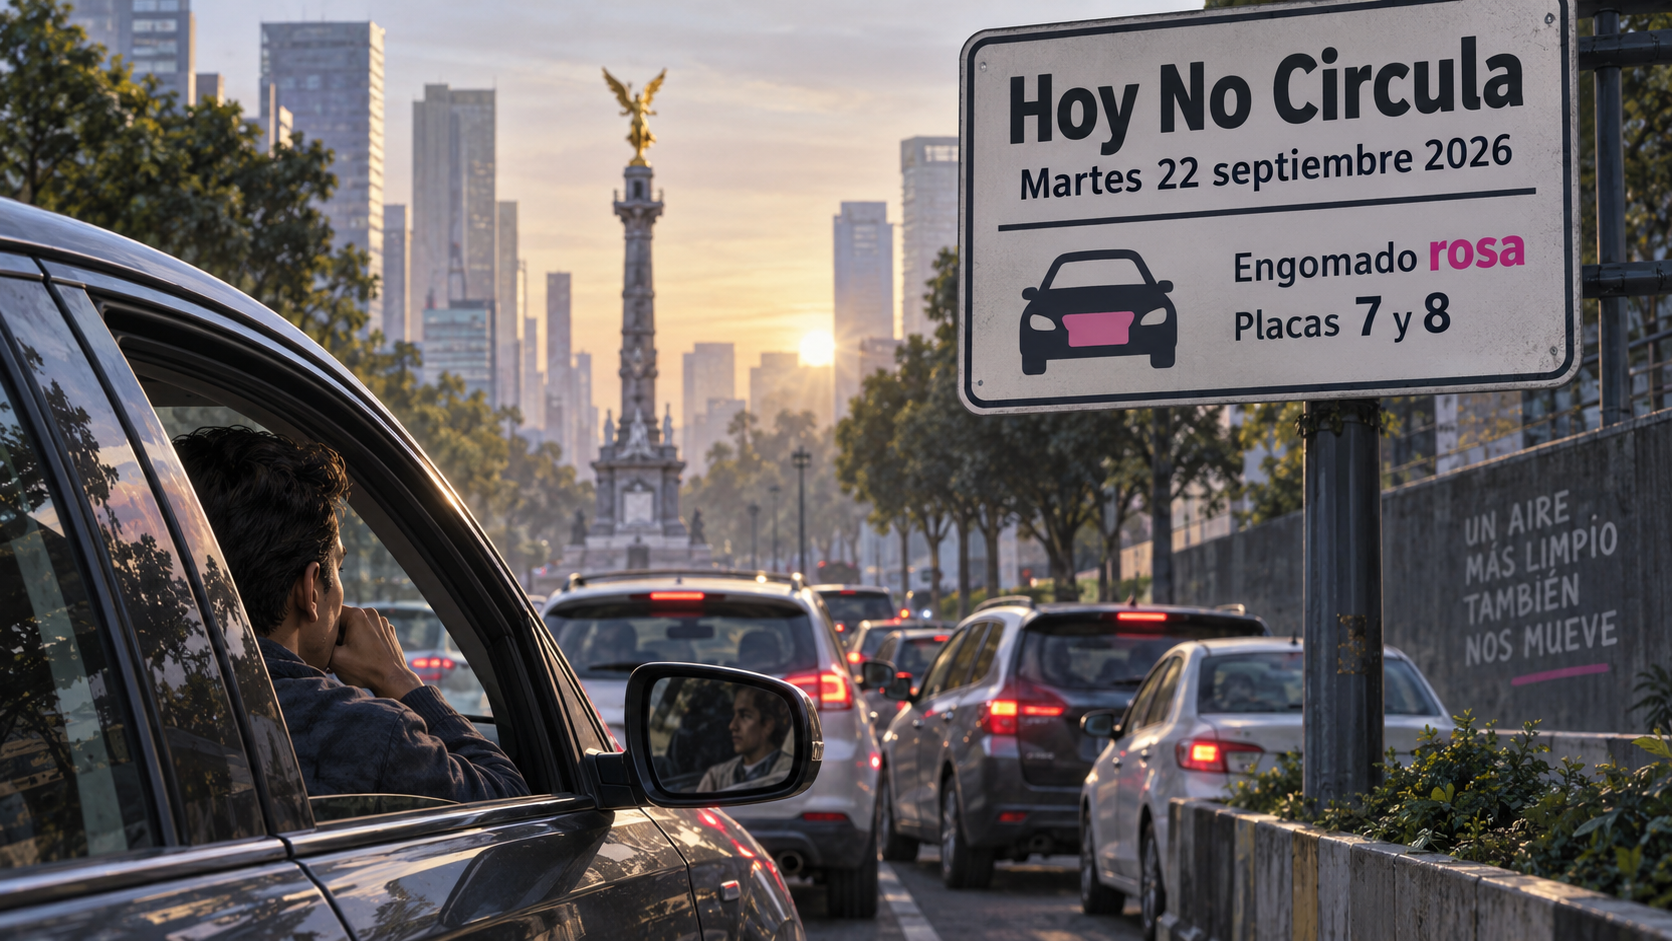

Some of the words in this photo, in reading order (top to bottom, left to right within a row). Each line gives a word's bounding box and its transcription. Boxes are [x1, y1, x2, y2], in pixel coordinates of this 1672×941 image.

[1009, 73, 1140, 156] Hoy
[1160, 61, 1252, 134] No
[1272, 35, 1524, 125] Circula
[1020, 164, 1143, 201] Martes
[1157, 156, 1199, 191] 22
[1212, 143, 1413, 192] septiembre
[1424, 133, 1513, 173] 2026
[1234, 240, 1418, 288] Engomado
[1429, 234, 1526, 271] rosa
[1235, 308, 1340, 342] Placas
[1355, 295, 1382, 337] 7
[1393, 311, 1413, 344] y
[1423, 291, 1451, 334] 8
[1465, 510, 1497, 546] UN
[1508, 489, 1571, 537] AIRE
[1465, 541, 1517, 587] MÁS
[1465, 628, 1514, 668] NOS
[1523, 609, 1619, 660] MUEVE
